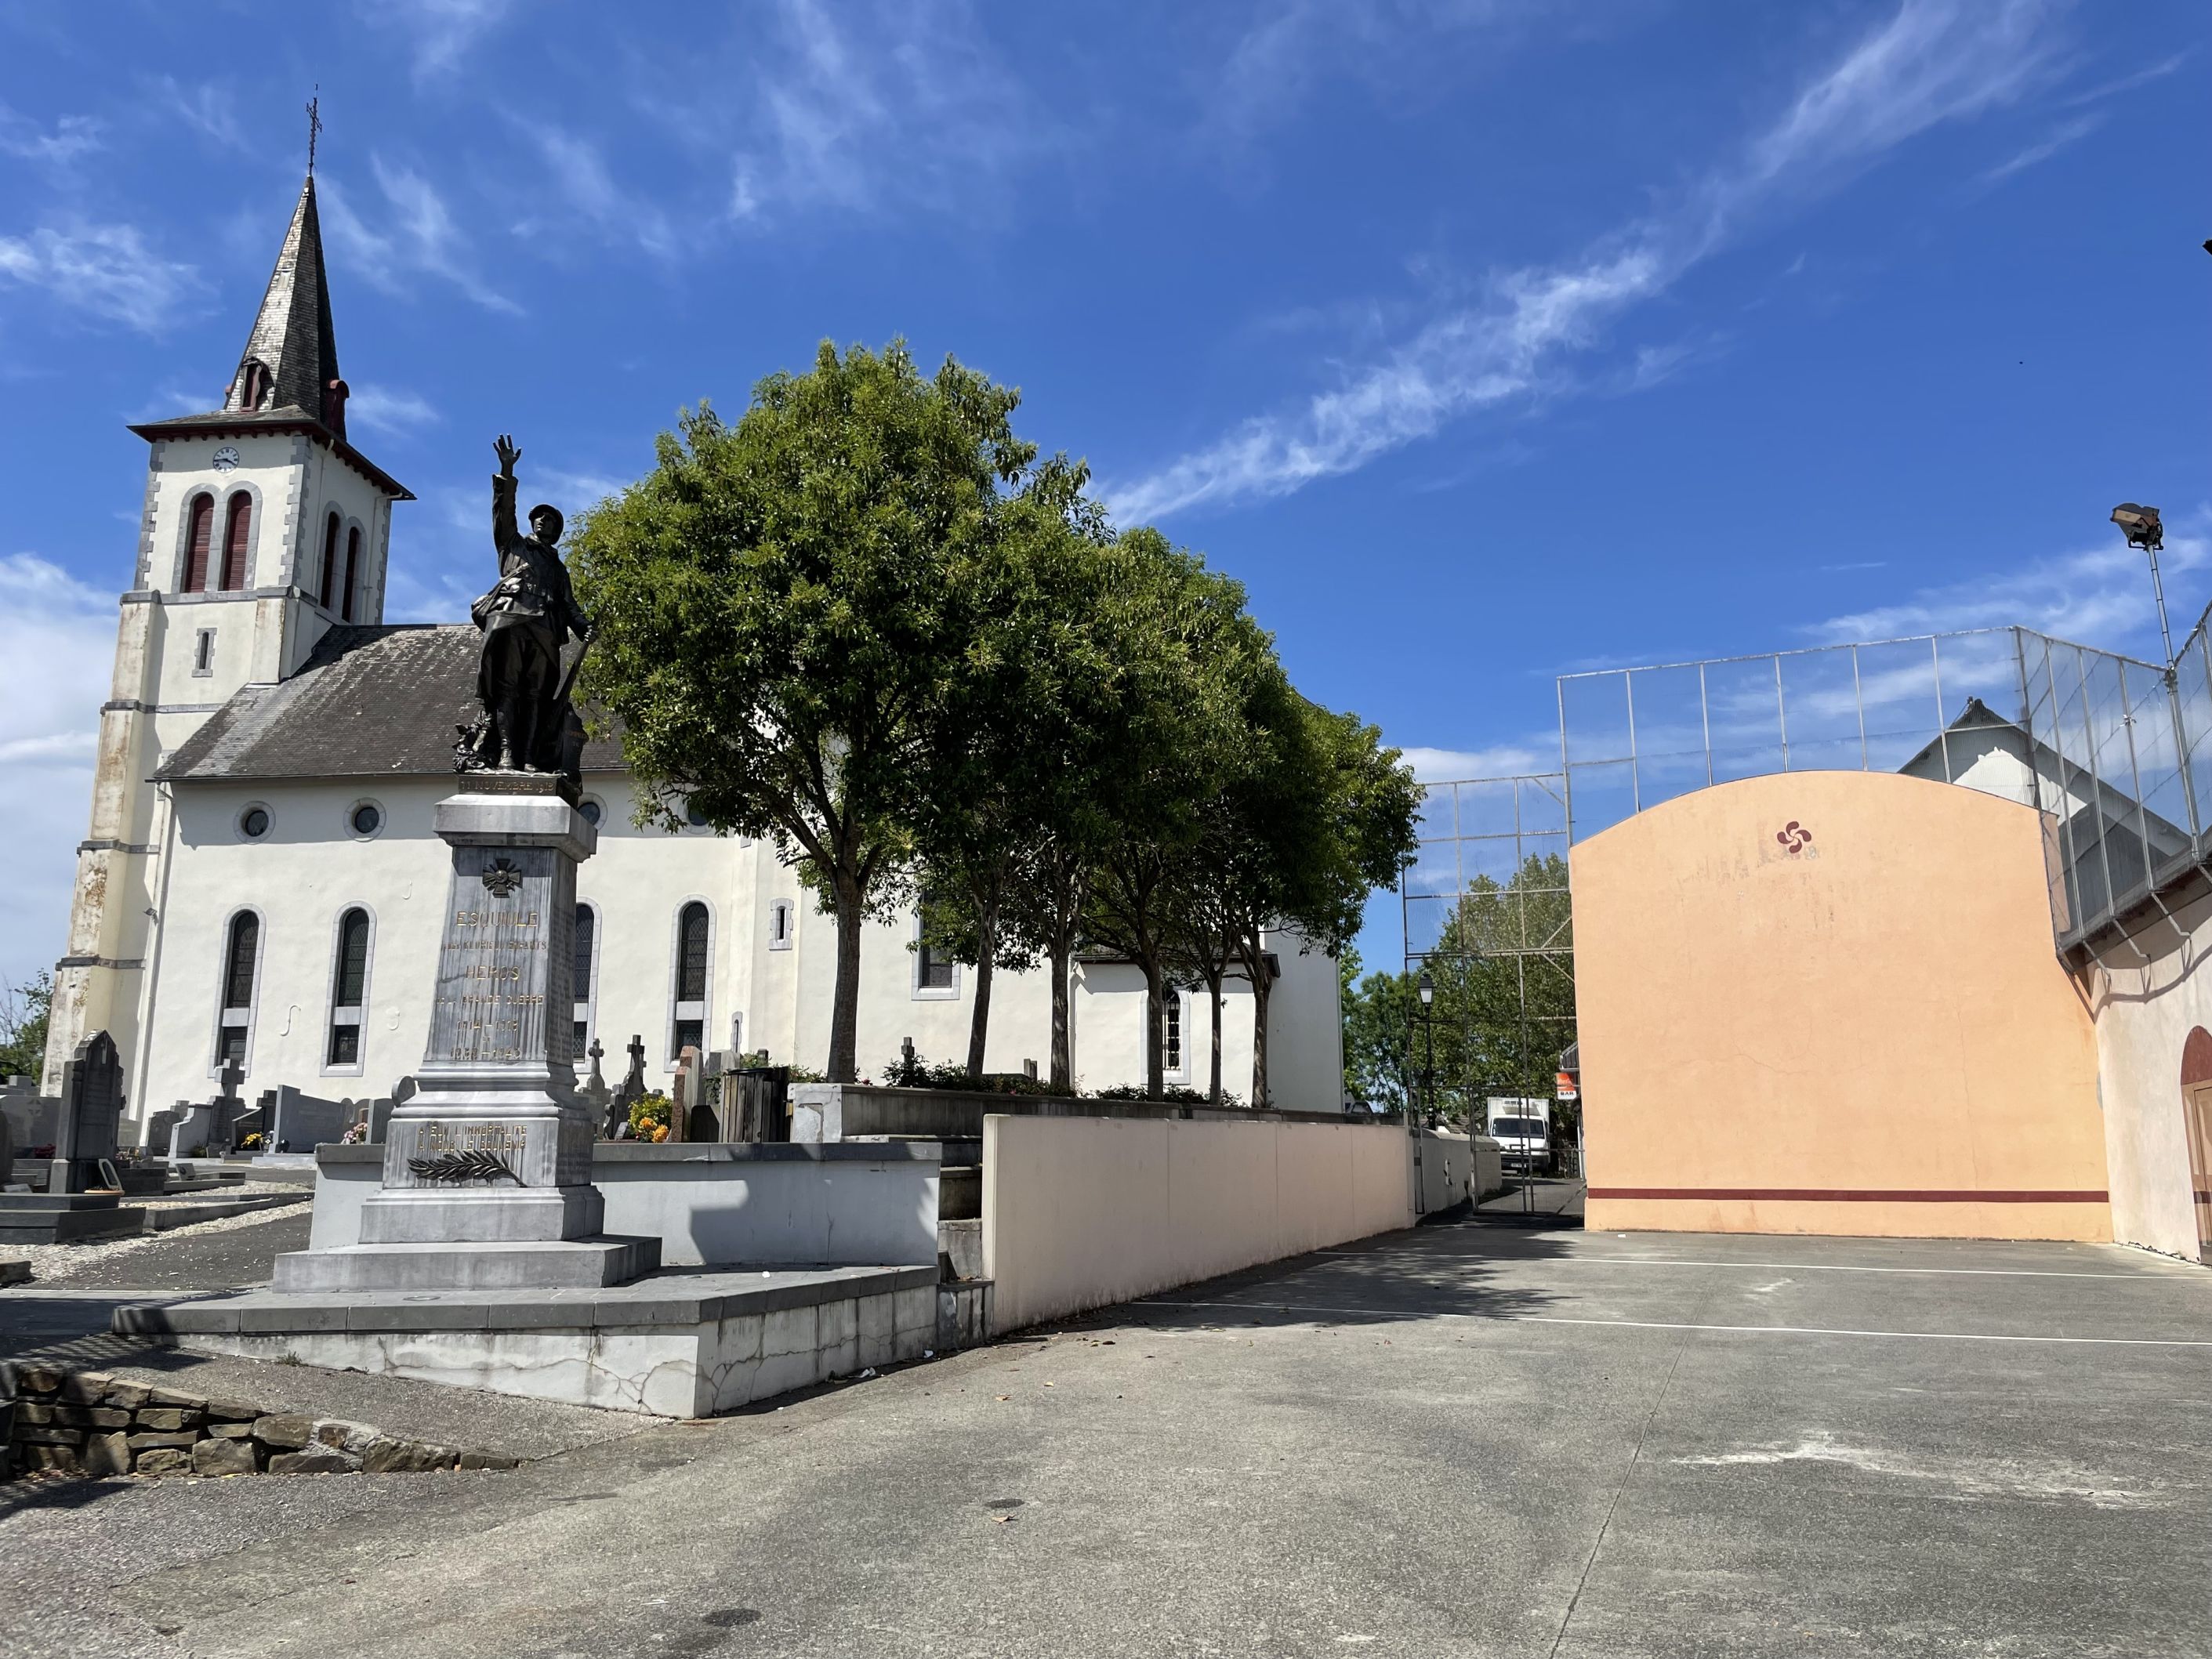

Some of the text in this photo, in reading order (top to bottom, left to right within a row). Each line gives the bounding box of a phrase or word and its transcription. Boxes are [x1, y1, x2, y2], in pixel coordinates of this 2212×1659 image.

[475, 781, 533, 791] NOVEMBRE
[536, 782, 554, 793] 1918
[506, 995, 544, 1005] GUERRE
